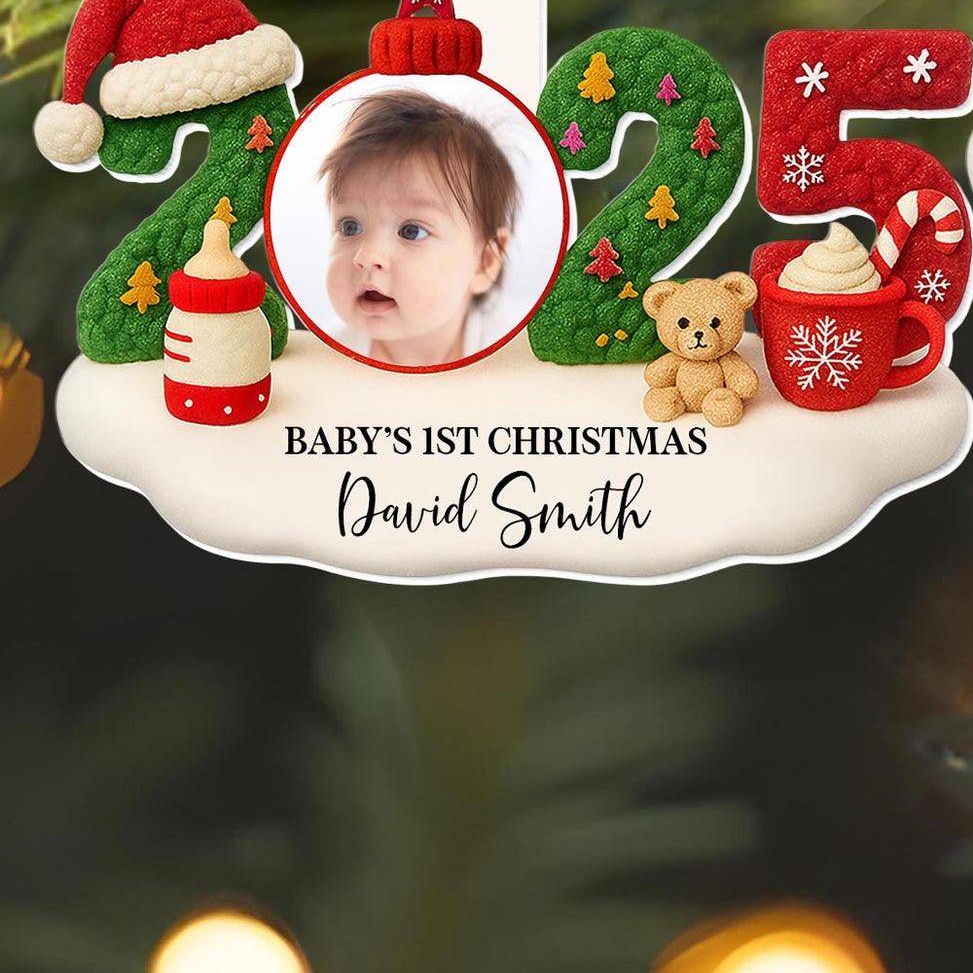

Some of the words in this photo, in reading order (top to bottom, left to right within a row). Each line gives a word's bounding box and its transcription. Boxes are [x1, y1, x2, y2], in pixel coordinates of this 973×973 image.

[284, 426, 412, 456] BABY’S
[422, 426, 479, 456] 1ST
[488, 426, 707, 456] CHRISTMAS
[338, 470, 479, 537] David
[491, 470, 652, 549] Smith
